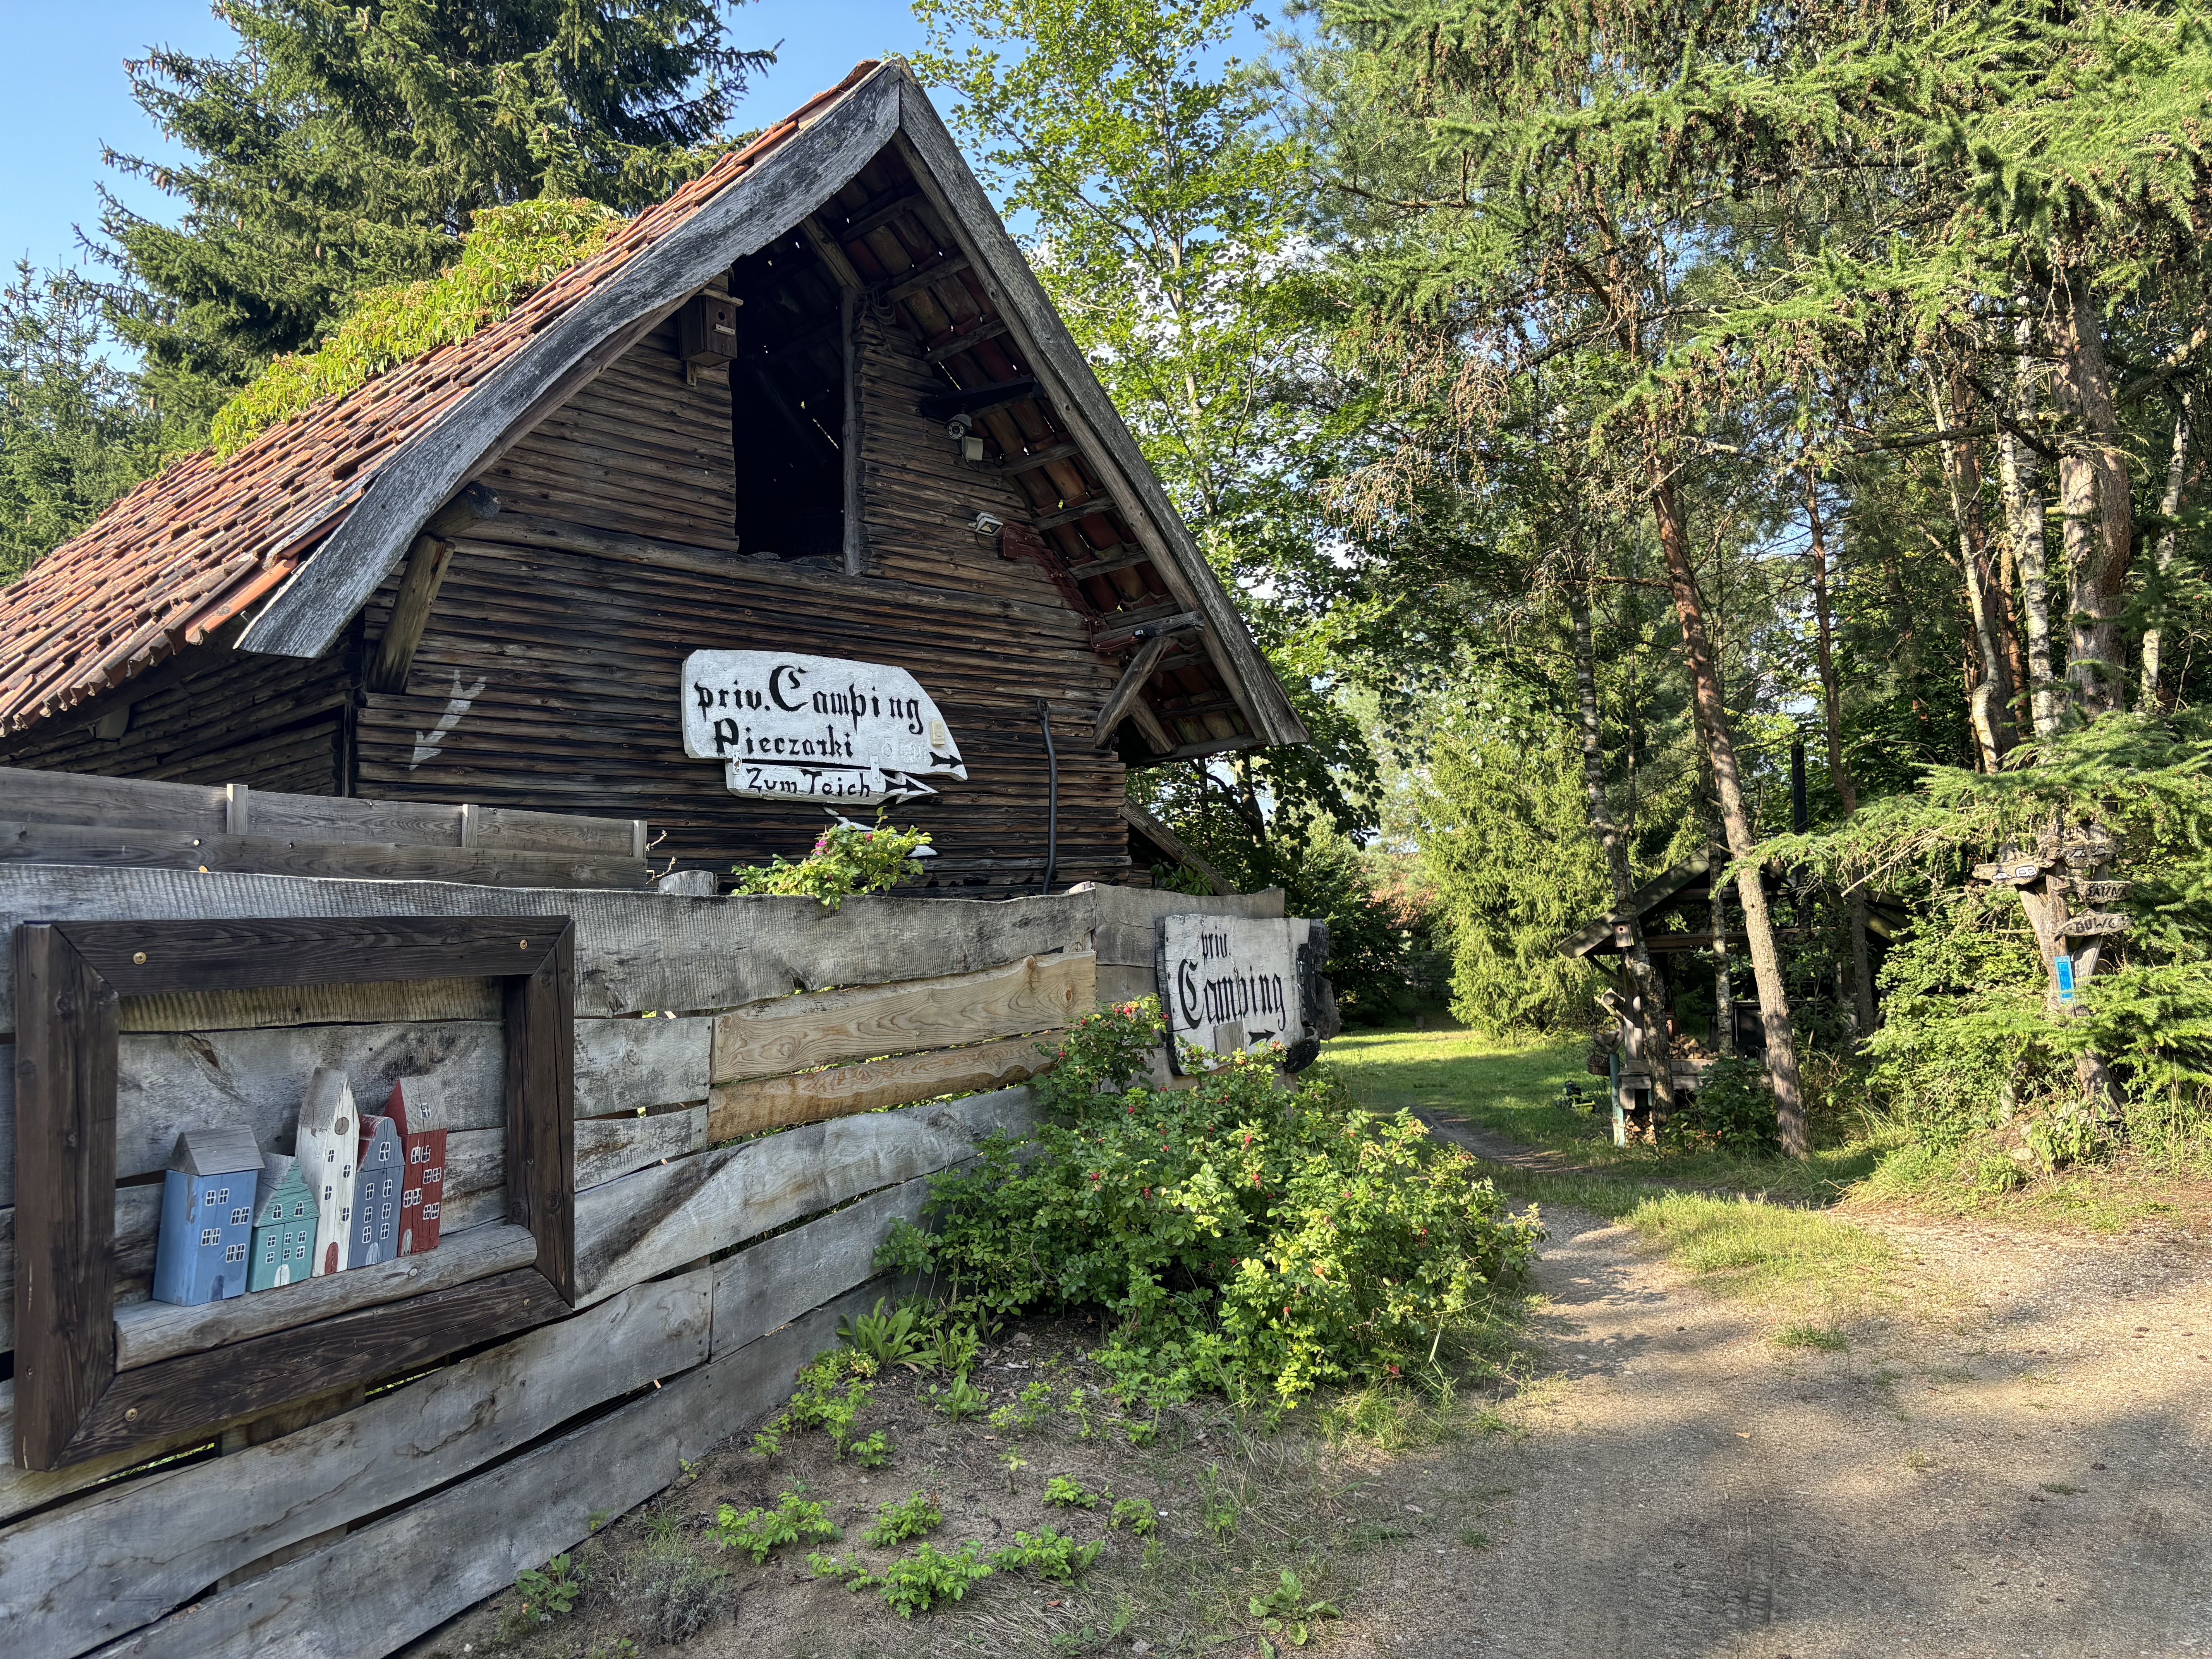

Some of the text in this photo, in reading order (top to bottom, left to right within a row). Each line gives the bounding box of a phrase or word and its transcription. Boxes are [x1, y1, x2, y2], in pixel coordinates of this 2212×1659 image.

[694, 665, 924, 735] priv. Camping
[713, 718, 854, 758] Pieczarki
[745, 767, 871, 797] Zum Teich
[1178, 958, 1286, 1032] Camping
